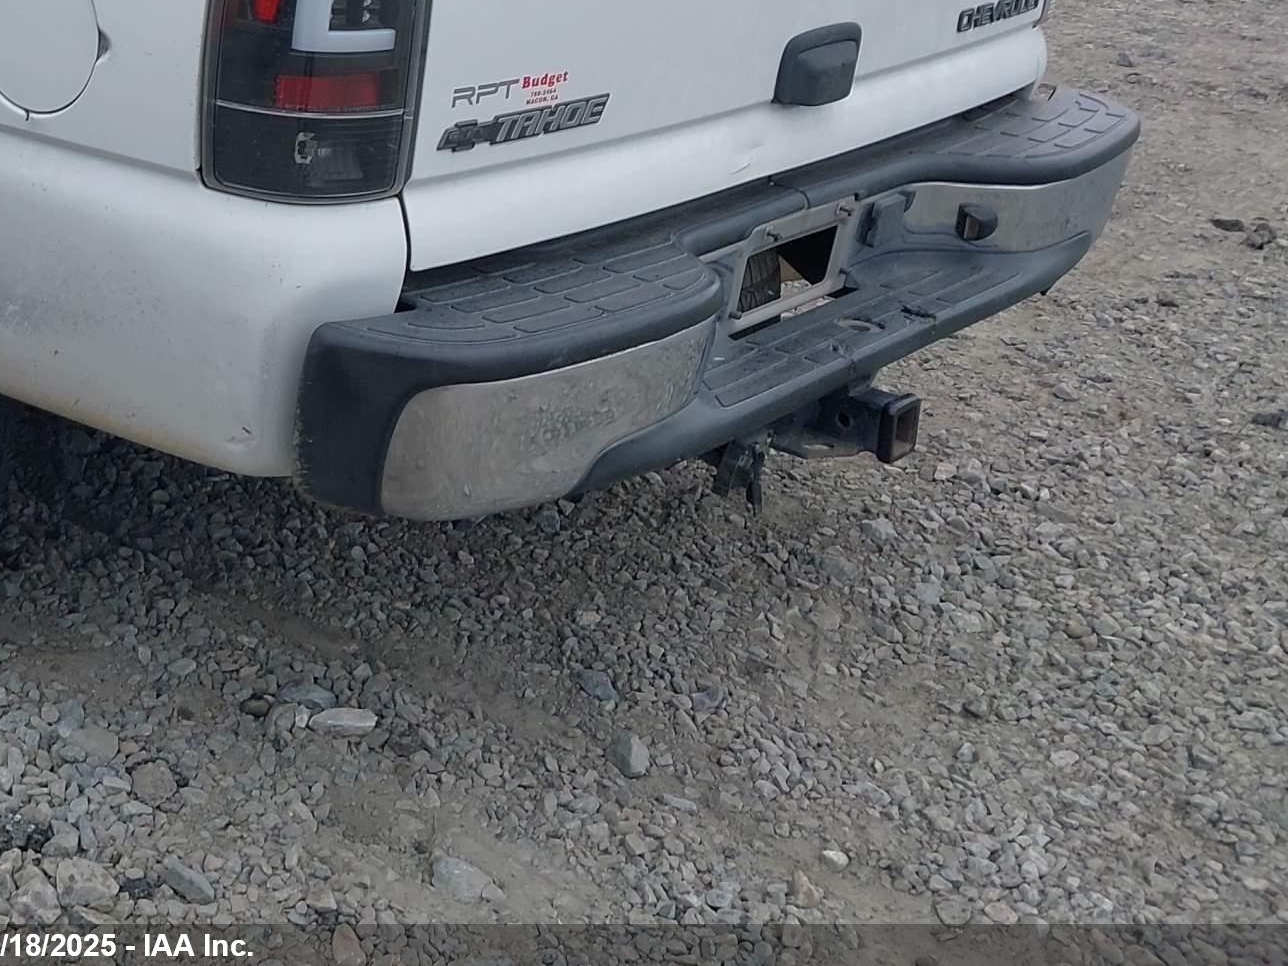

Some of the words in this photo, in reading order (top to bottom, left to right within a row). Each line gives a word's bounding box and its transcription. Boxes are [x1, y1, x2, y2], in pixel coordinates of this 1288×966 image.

[451, 78, 520, 108] RPT
[522, 70, 569, 89] Budget
[494, 95, 609, 143] TAHOE
